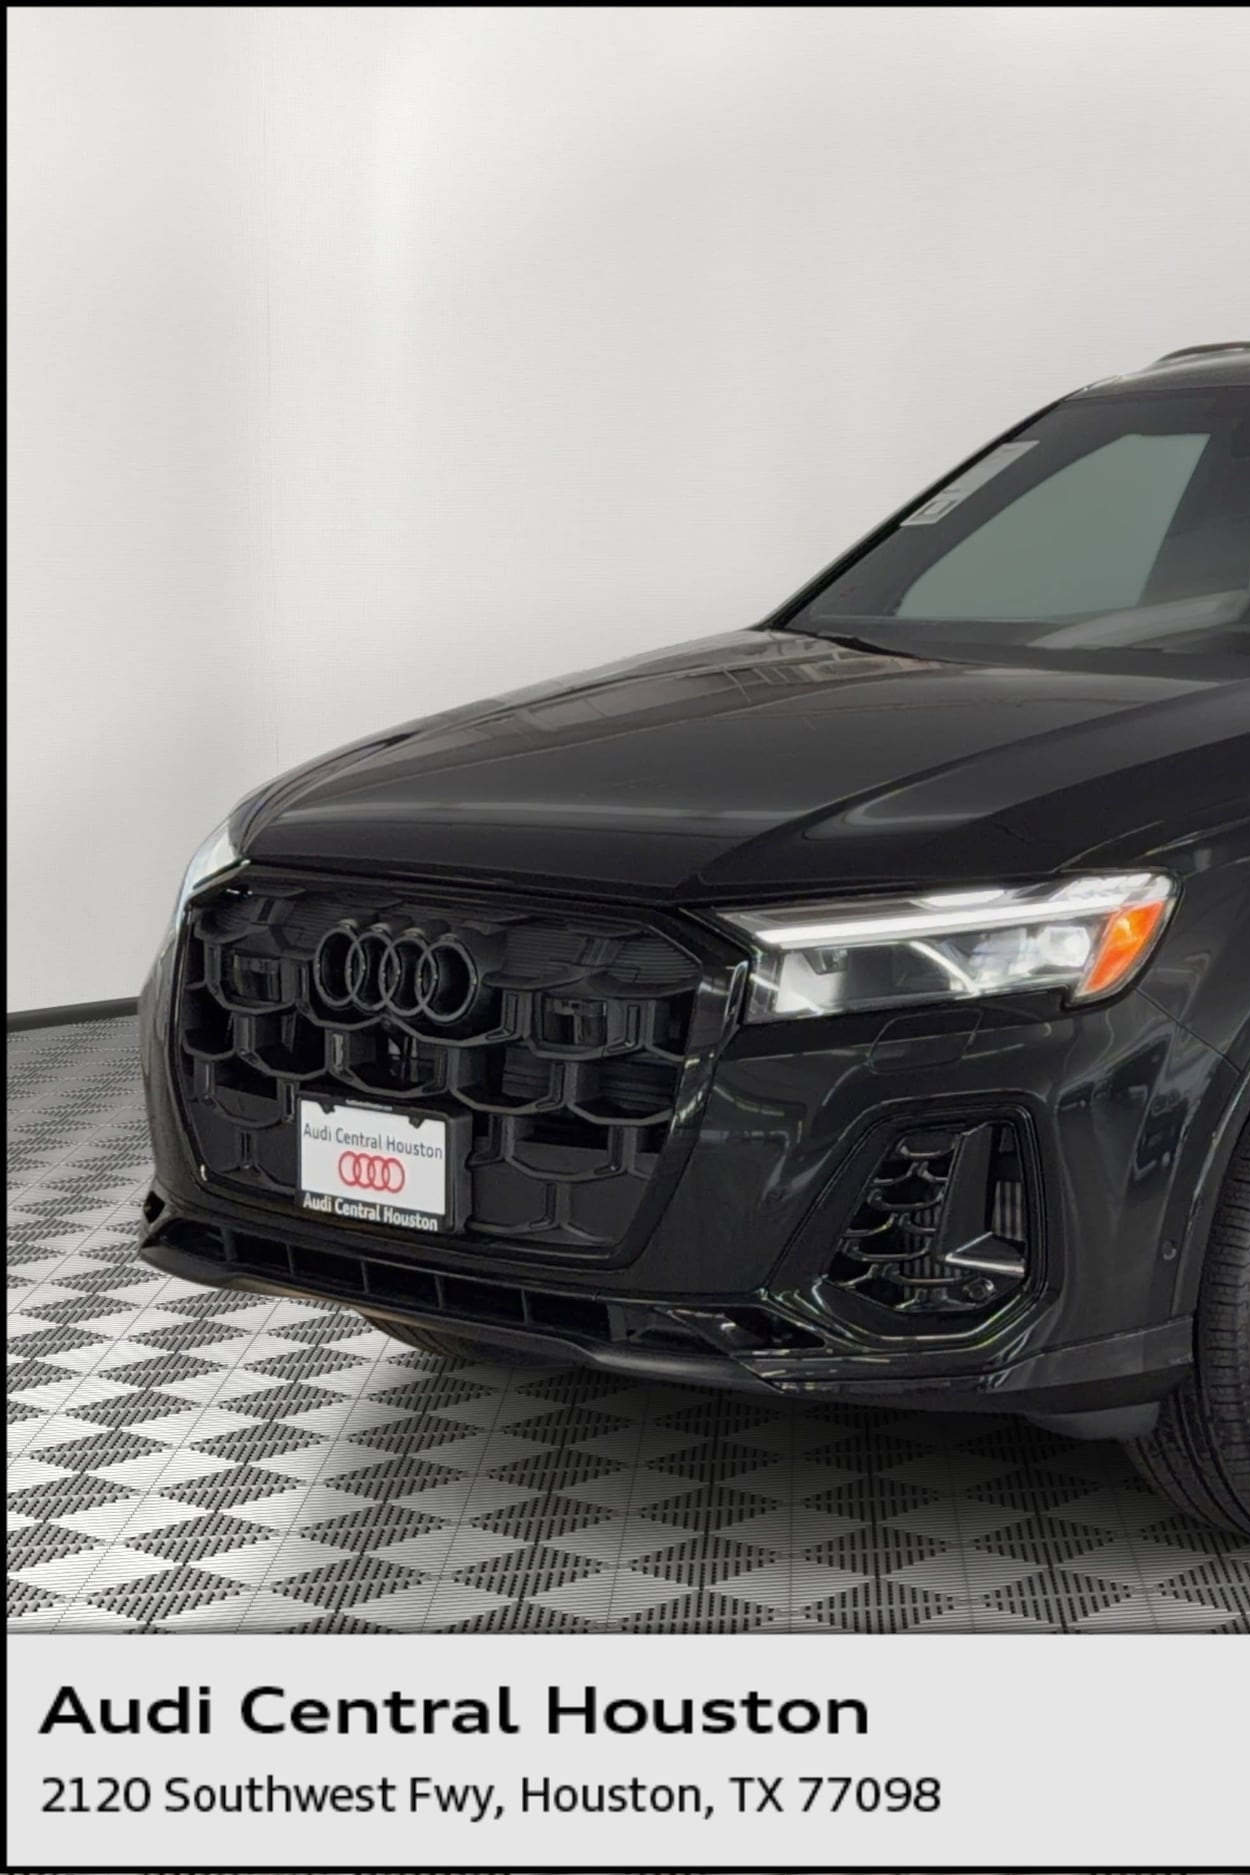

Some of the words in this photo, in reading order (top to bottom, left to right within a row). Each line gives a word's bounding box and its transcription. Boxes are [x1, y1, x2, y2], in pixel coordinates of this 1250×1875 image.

[303, 1122, 332, 1142] Audi
[335, 1127, 382, 1150] Central
[386, 1135, 443, 1159] Houston
[303, 1192, 332, 1213] Audi
[334, 1195, 380, 1221] Central
[383, 1208, 438, 1231] Houston
